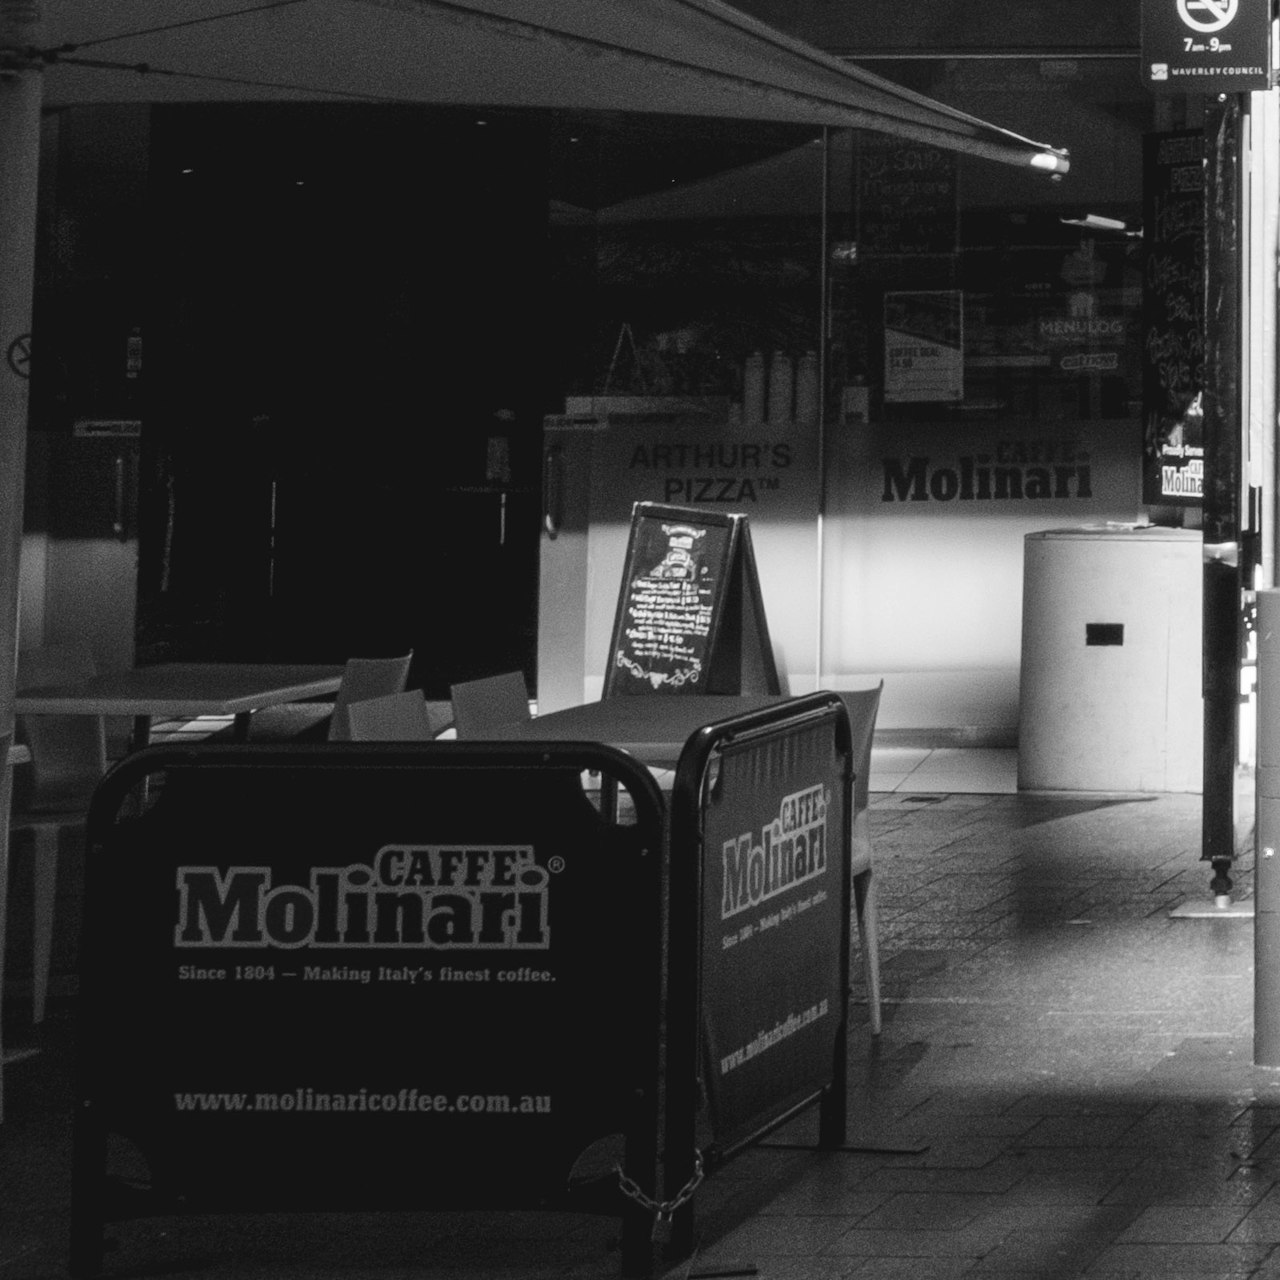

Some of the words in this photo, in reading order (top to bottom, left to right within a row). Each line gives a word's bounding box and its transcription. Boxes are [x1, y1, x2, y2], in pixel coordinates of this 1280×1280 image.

[1172, 66, 1221, 76] WAVERLEY
[1222, 66, 1264, 76] COUNCIL
[1039, 319, 1123, 335] MENULOG
[629, 443, 791, 469] ARTHUR'S
[881, 453, 1093, 503] Molinari
[721, 806, 827, 921] Molinari
[174, 860, 551, 951] Molinari
[177, 966, 227, 983] Since
[233, 966, 276, 983] 1804
[302, 966, 371, 985] Making
[378, 966, 433, 985] Italy's
[438, 966, 491, 983] finest
[496, 966, 557, 983] coffee.
[173, 1087, 552, 1114] www.molinaricoffee.com.au
